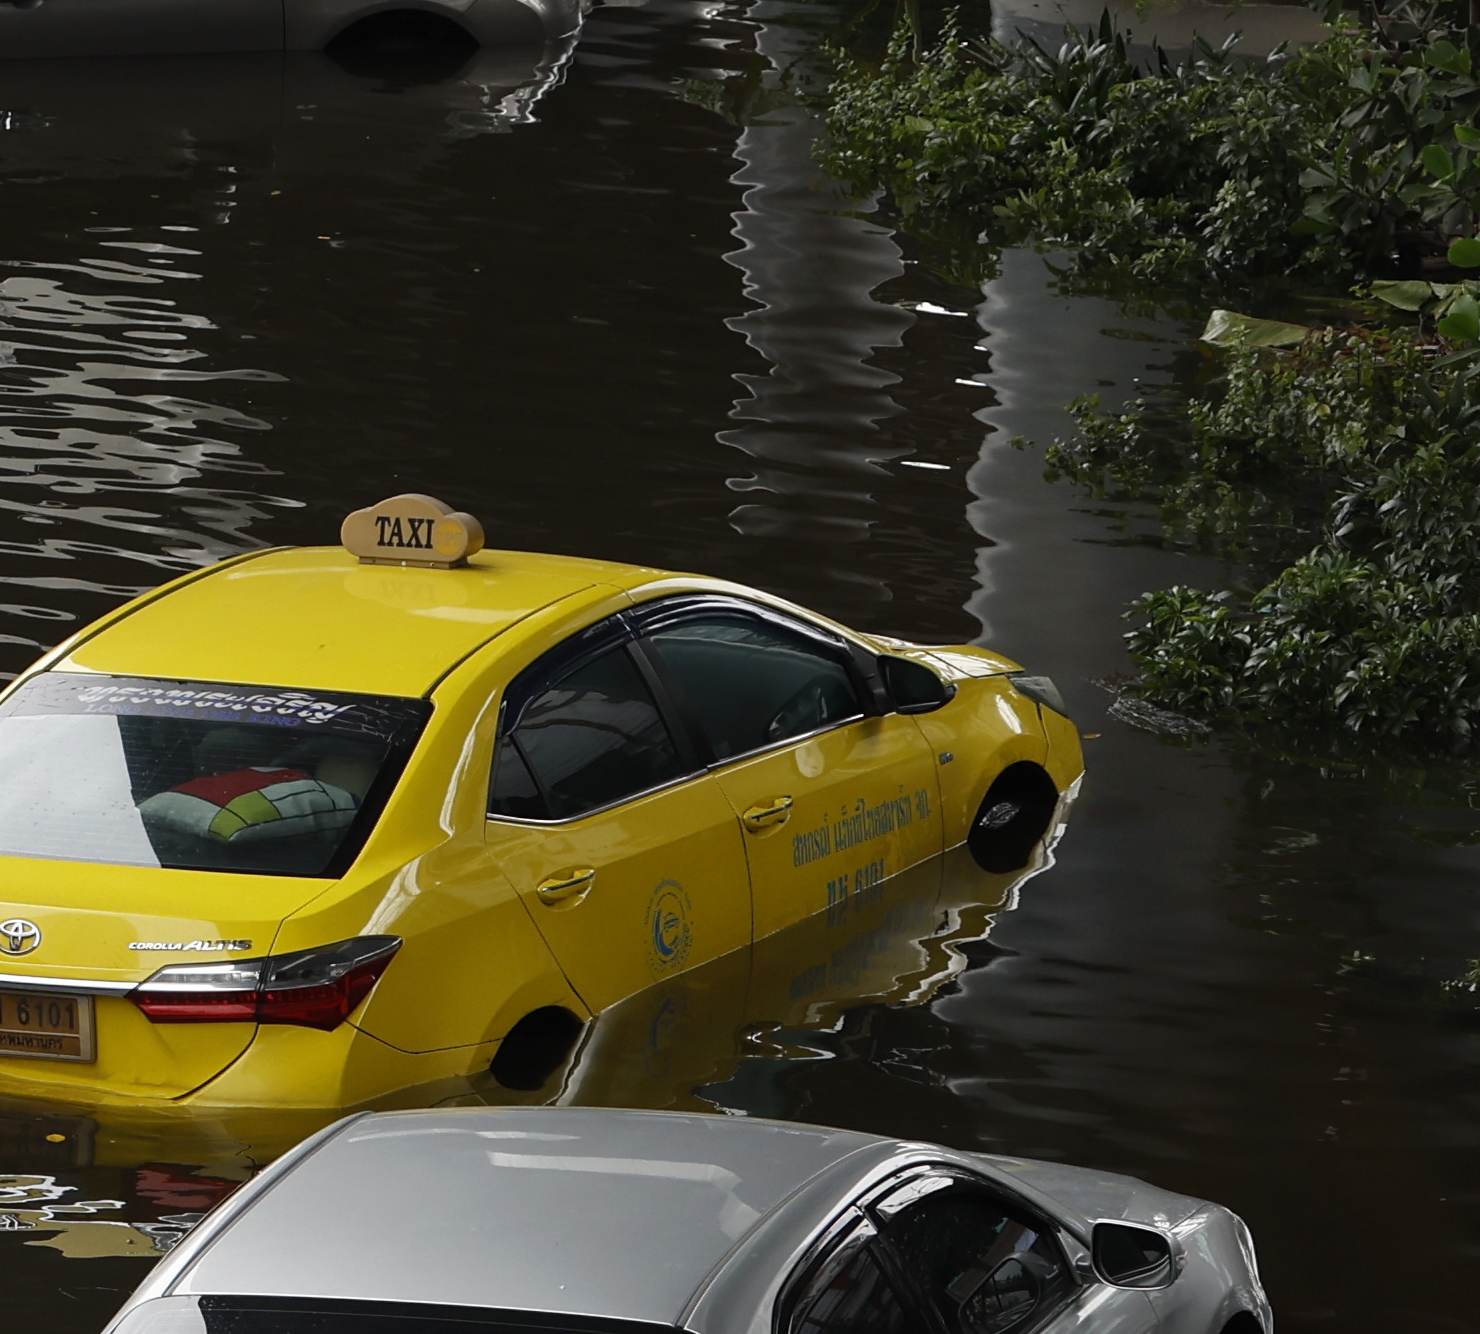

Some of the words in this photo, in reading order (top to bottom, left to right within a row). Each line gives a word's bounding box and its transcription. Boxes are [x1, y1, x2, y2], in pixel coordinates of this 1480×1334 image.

[375, 516, 435, 549] TAXI
[248, 713, 301, 727] KING
[128, 942, 183, 951] COROLLA
[183, 940, 253, 951] ALTIS
[17, 998, 75, 1029] 6101
